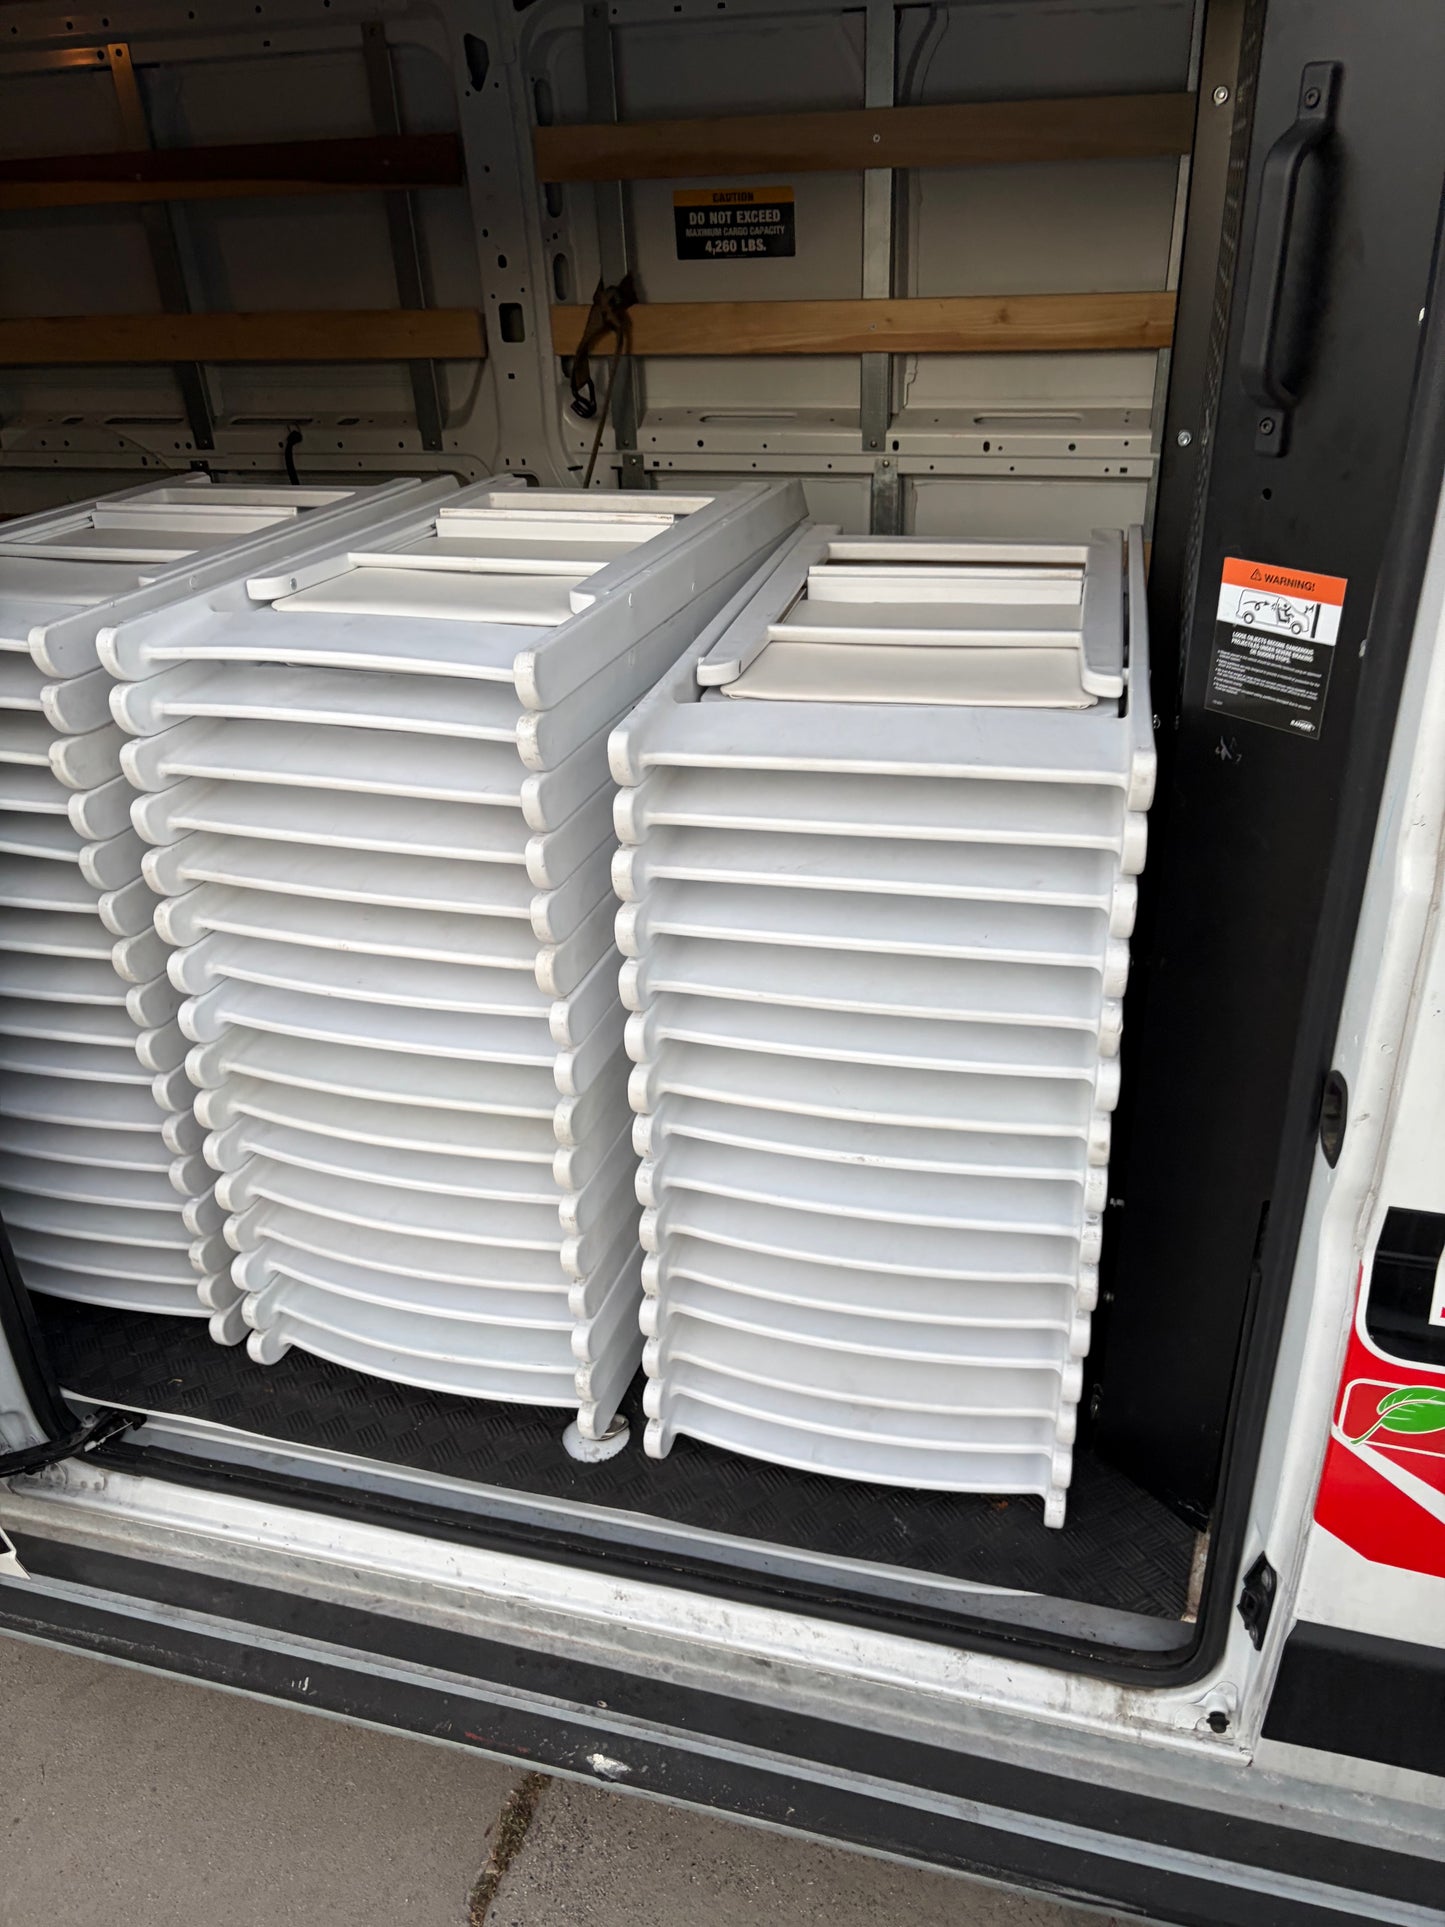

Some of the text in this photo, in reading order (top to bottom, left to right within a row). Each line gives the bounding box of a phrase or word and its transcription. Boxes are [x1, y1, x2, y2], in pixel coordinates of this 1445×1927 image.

[713, 192, 754, 203] CAUTION
[689, 209, 781, 225] DO NOT EXCEED
[686, 225, 785, 237] MAXIMUM CARGO CAPACITY
[705, 238, 767, 255] 4,260 LBS.
[1264, 573, 1316, 592] WARNING!
